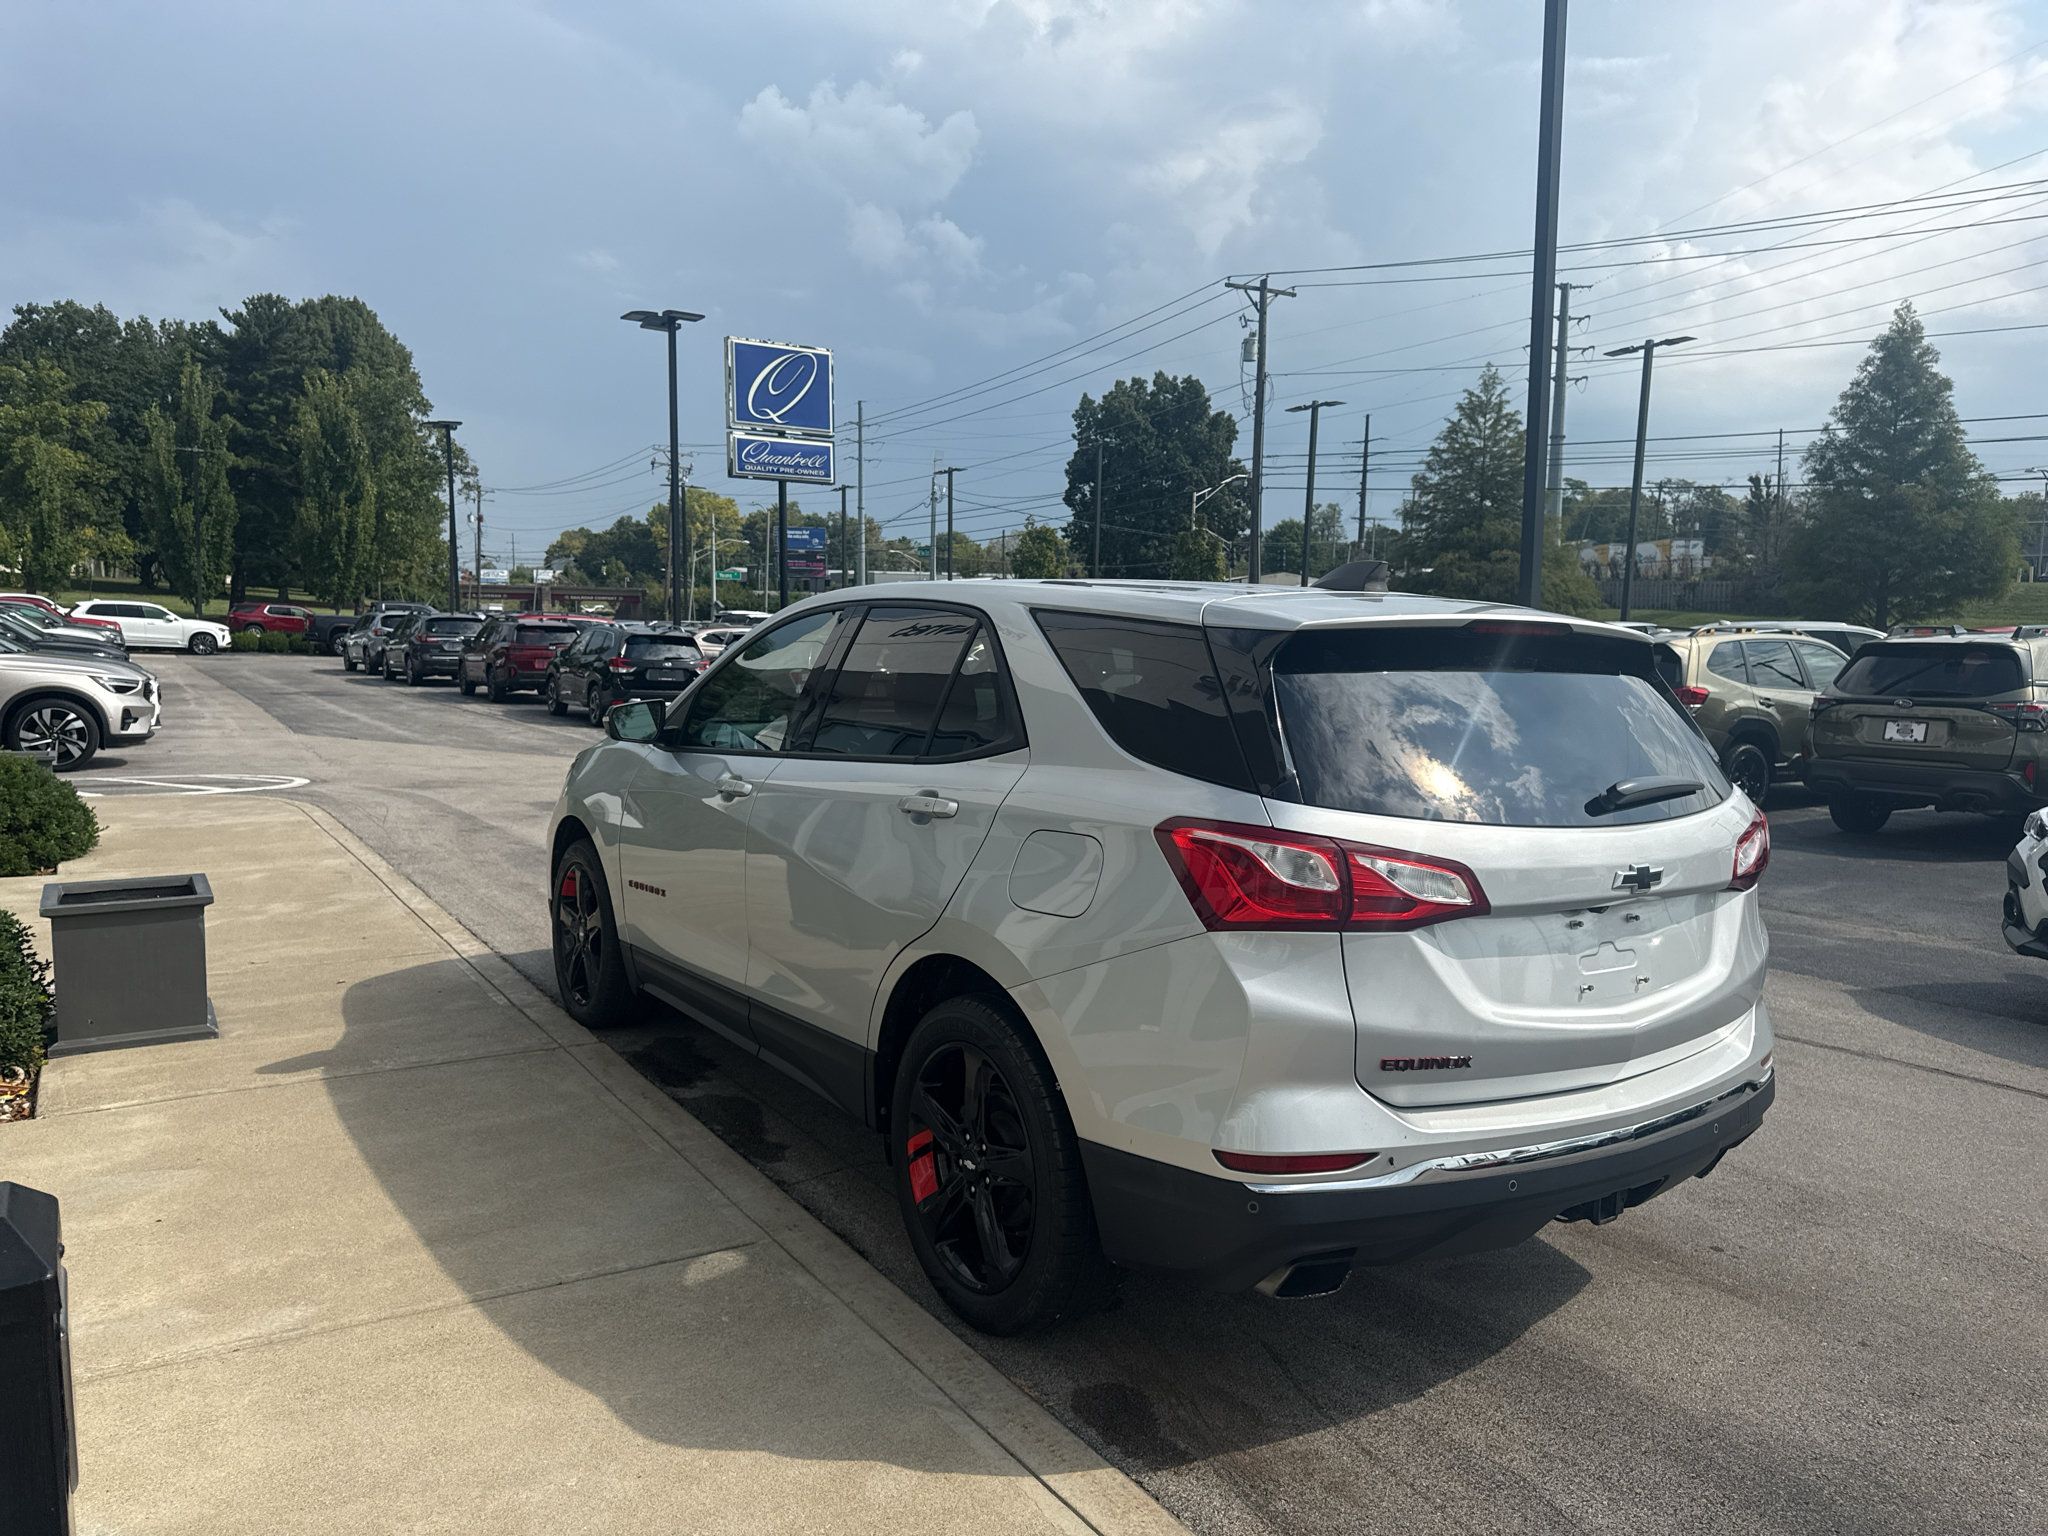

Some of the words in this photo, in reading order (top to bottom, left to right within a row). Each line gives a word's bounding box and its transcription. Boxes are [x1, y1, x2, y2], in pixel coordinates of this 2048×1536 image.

[747, 352, 818, 424] Q
[741, 441, 828, 468] Quantrell
[744, 464, 778, 473] QUALITY
[779, 466, 825, 476] PRE-OWNED
[628, 879, 667, 898] EQUINOX
[1379, 1056, 1473, 1073] EQUINOX
